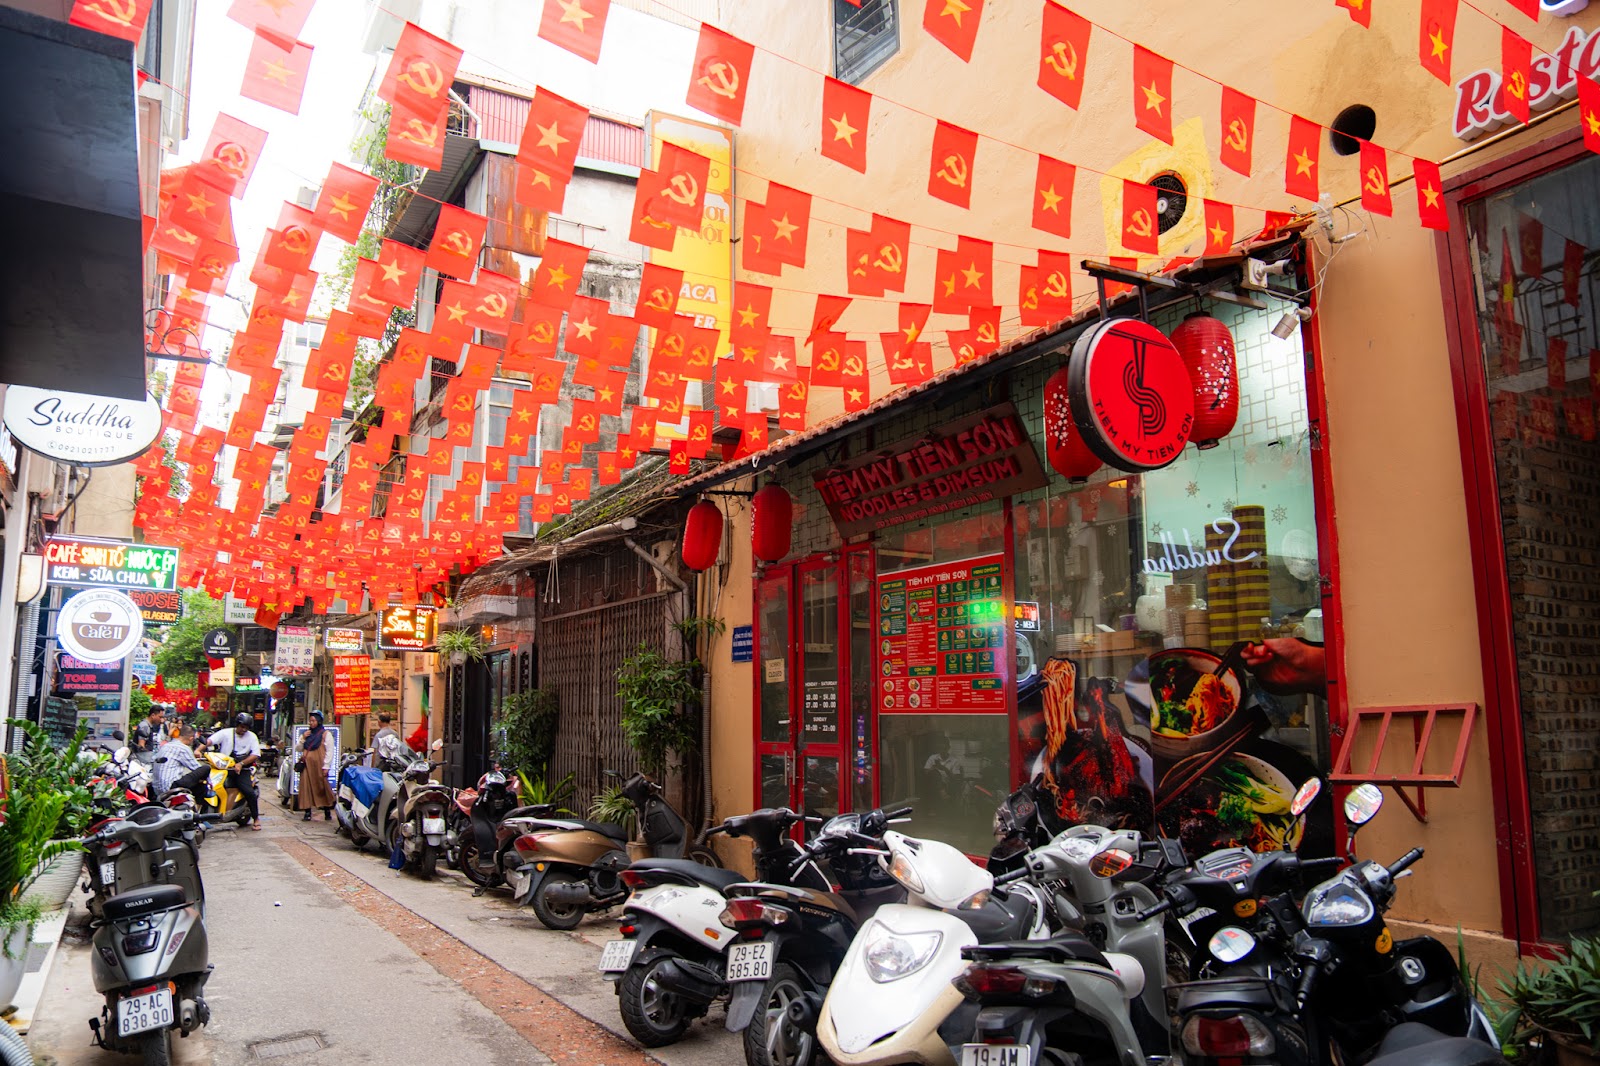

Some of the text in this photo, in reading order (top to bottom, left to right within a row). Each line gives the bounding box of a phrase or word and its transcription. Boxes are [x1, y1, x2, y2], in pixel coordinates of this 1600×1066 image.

[27, 397, 135, 429] Suddha
[55, 425, 133, 440] BOUTIQUE
[839, 453, 1022, 524] NOODLES & DIMSUM
[53, 566, 79, 579] KEM
[79, 624, 111, 640] Café
[393, 637, 424, 647] Waxing
[64, 673, 97, 682] TOUR
[125, 897, 153, 909] OSAKAR
[734, 944, 766, 962] 29-E2
[729, 961, 769, 980] 585.80
[126, 993, 164, 1016] 29-AC
[122, 1008, 169, 1034] 838.90
